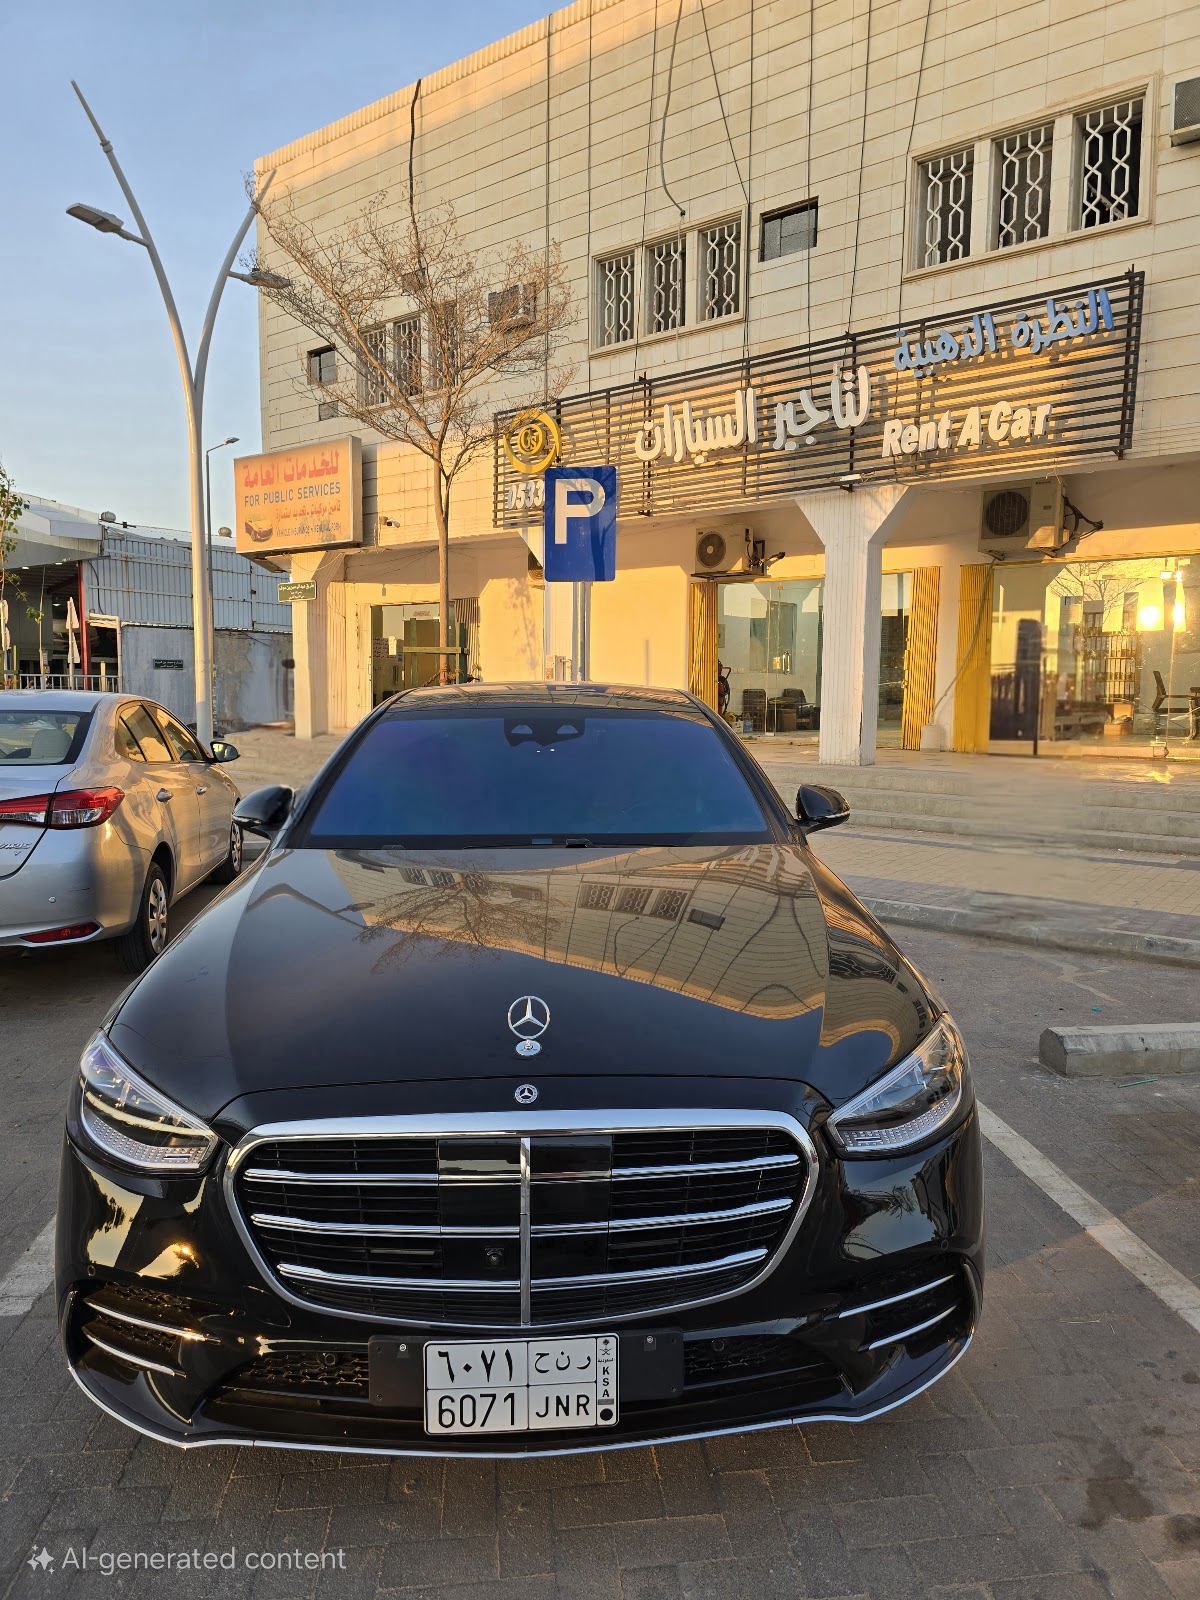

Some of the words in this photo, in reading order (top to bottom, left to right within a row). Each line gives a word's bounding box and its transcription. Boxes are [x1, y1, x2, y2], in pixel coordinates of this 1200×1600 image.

[893, 312, 999, 379] الذهبية
[1011, 288, 1115, 354] النظرة
[634, 387, 758, 464] السيارات
[772, 363, 872, 450] لتأجير
[881, 410, 952, 458] Rent
[956, 406, 982, 447] A
[988, 401, 1053, 442] Car
[242, 461, 280, 489] العامة
[283, 448, 340, 483] للخدمات
[244, 495, 260, 508] FOR
[263, 488, 294, 505] PUBLIC
[297, 481, 341, 500] SERVICES
[554, 478, 606, 545] P
[437, 1348, 514, 1384] ٦٠٧١
[438, 1392, 515, 1429] 6071
[535, 1394, 590, 1418] JNR
